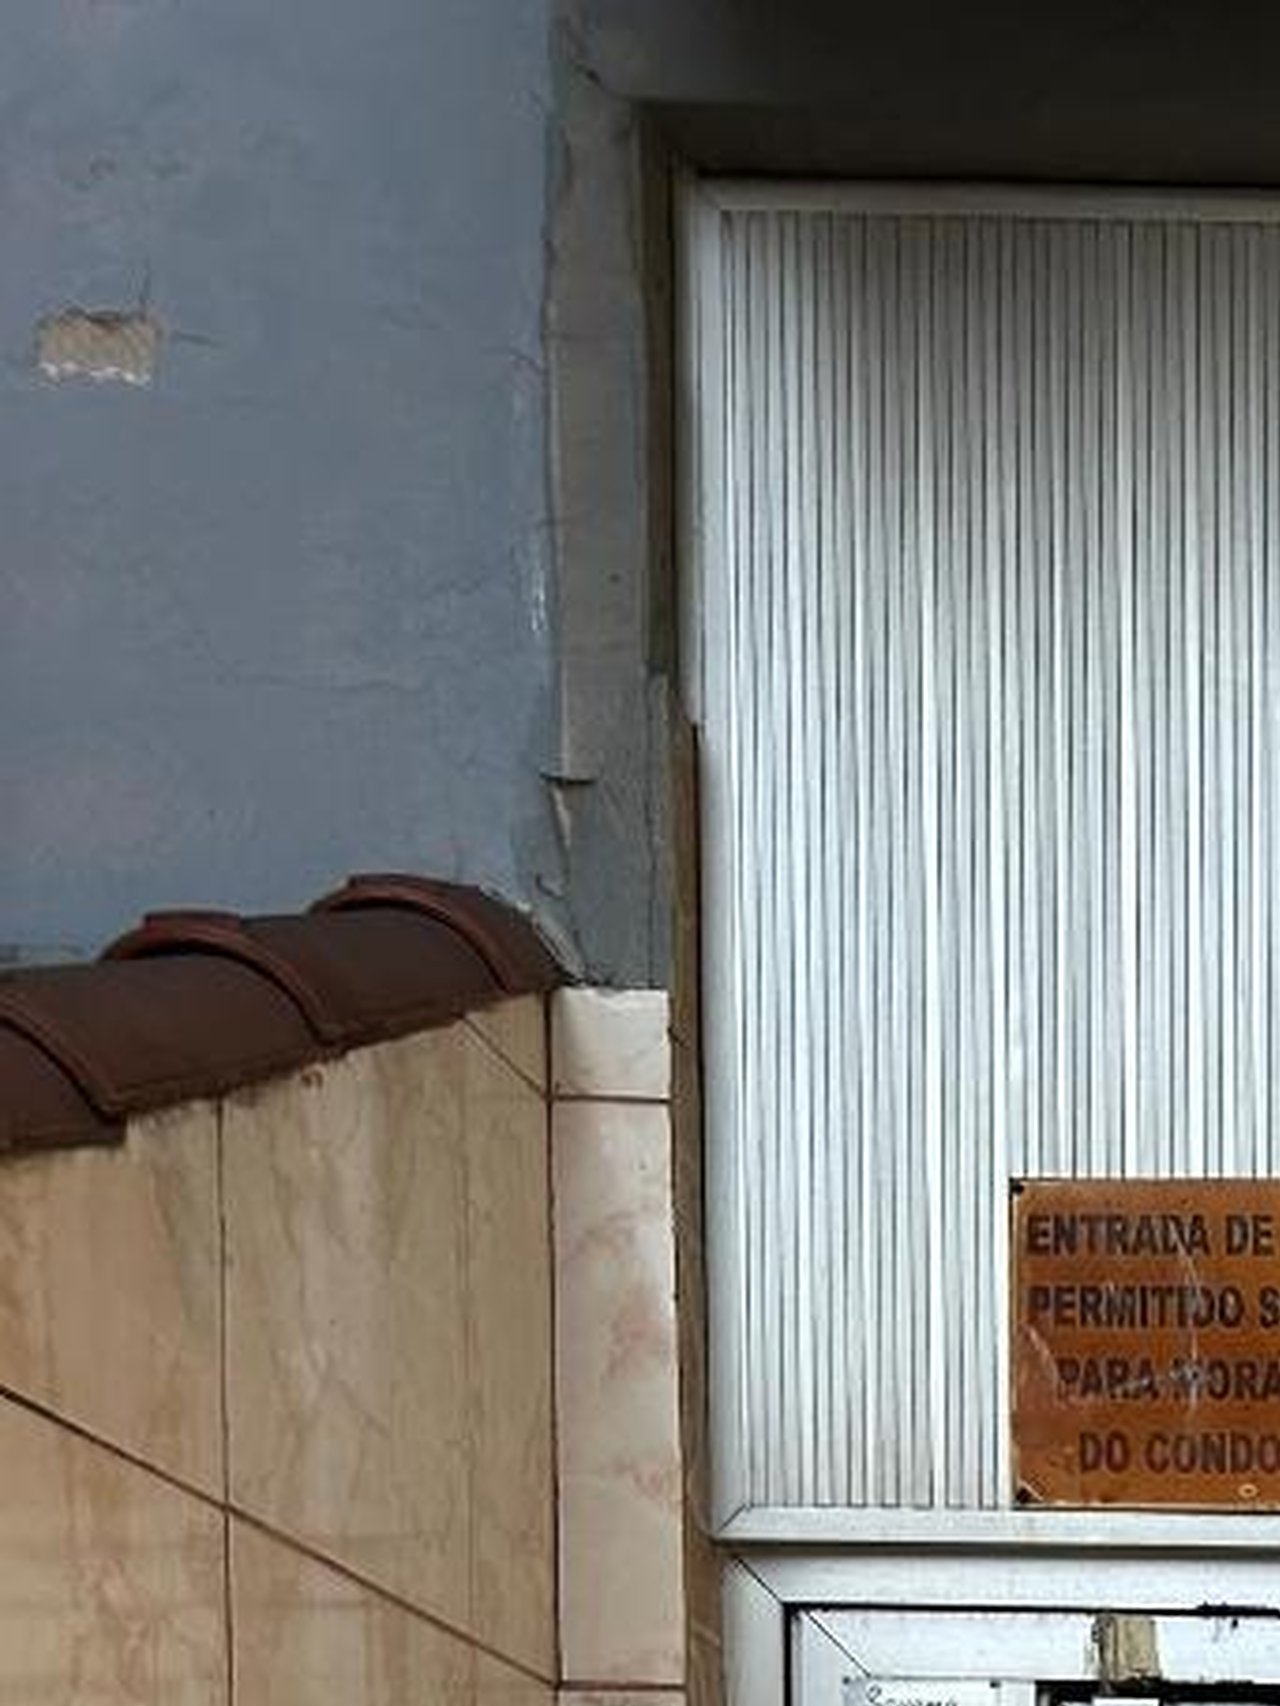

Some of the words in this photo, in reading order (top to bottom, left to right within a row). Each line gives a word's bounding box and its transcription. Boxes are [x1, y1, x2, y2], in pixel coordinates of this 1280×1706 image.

[1025, 1213, 1211, 1258] ENTRADA
[1226, 1216, 1273, 1256] DE
[1027, 1286, 1246, 1331] PERMITIDO
[1057, 1358, 1159, 1400] PARA
[1079, 1431, 1132, 1475] DO
